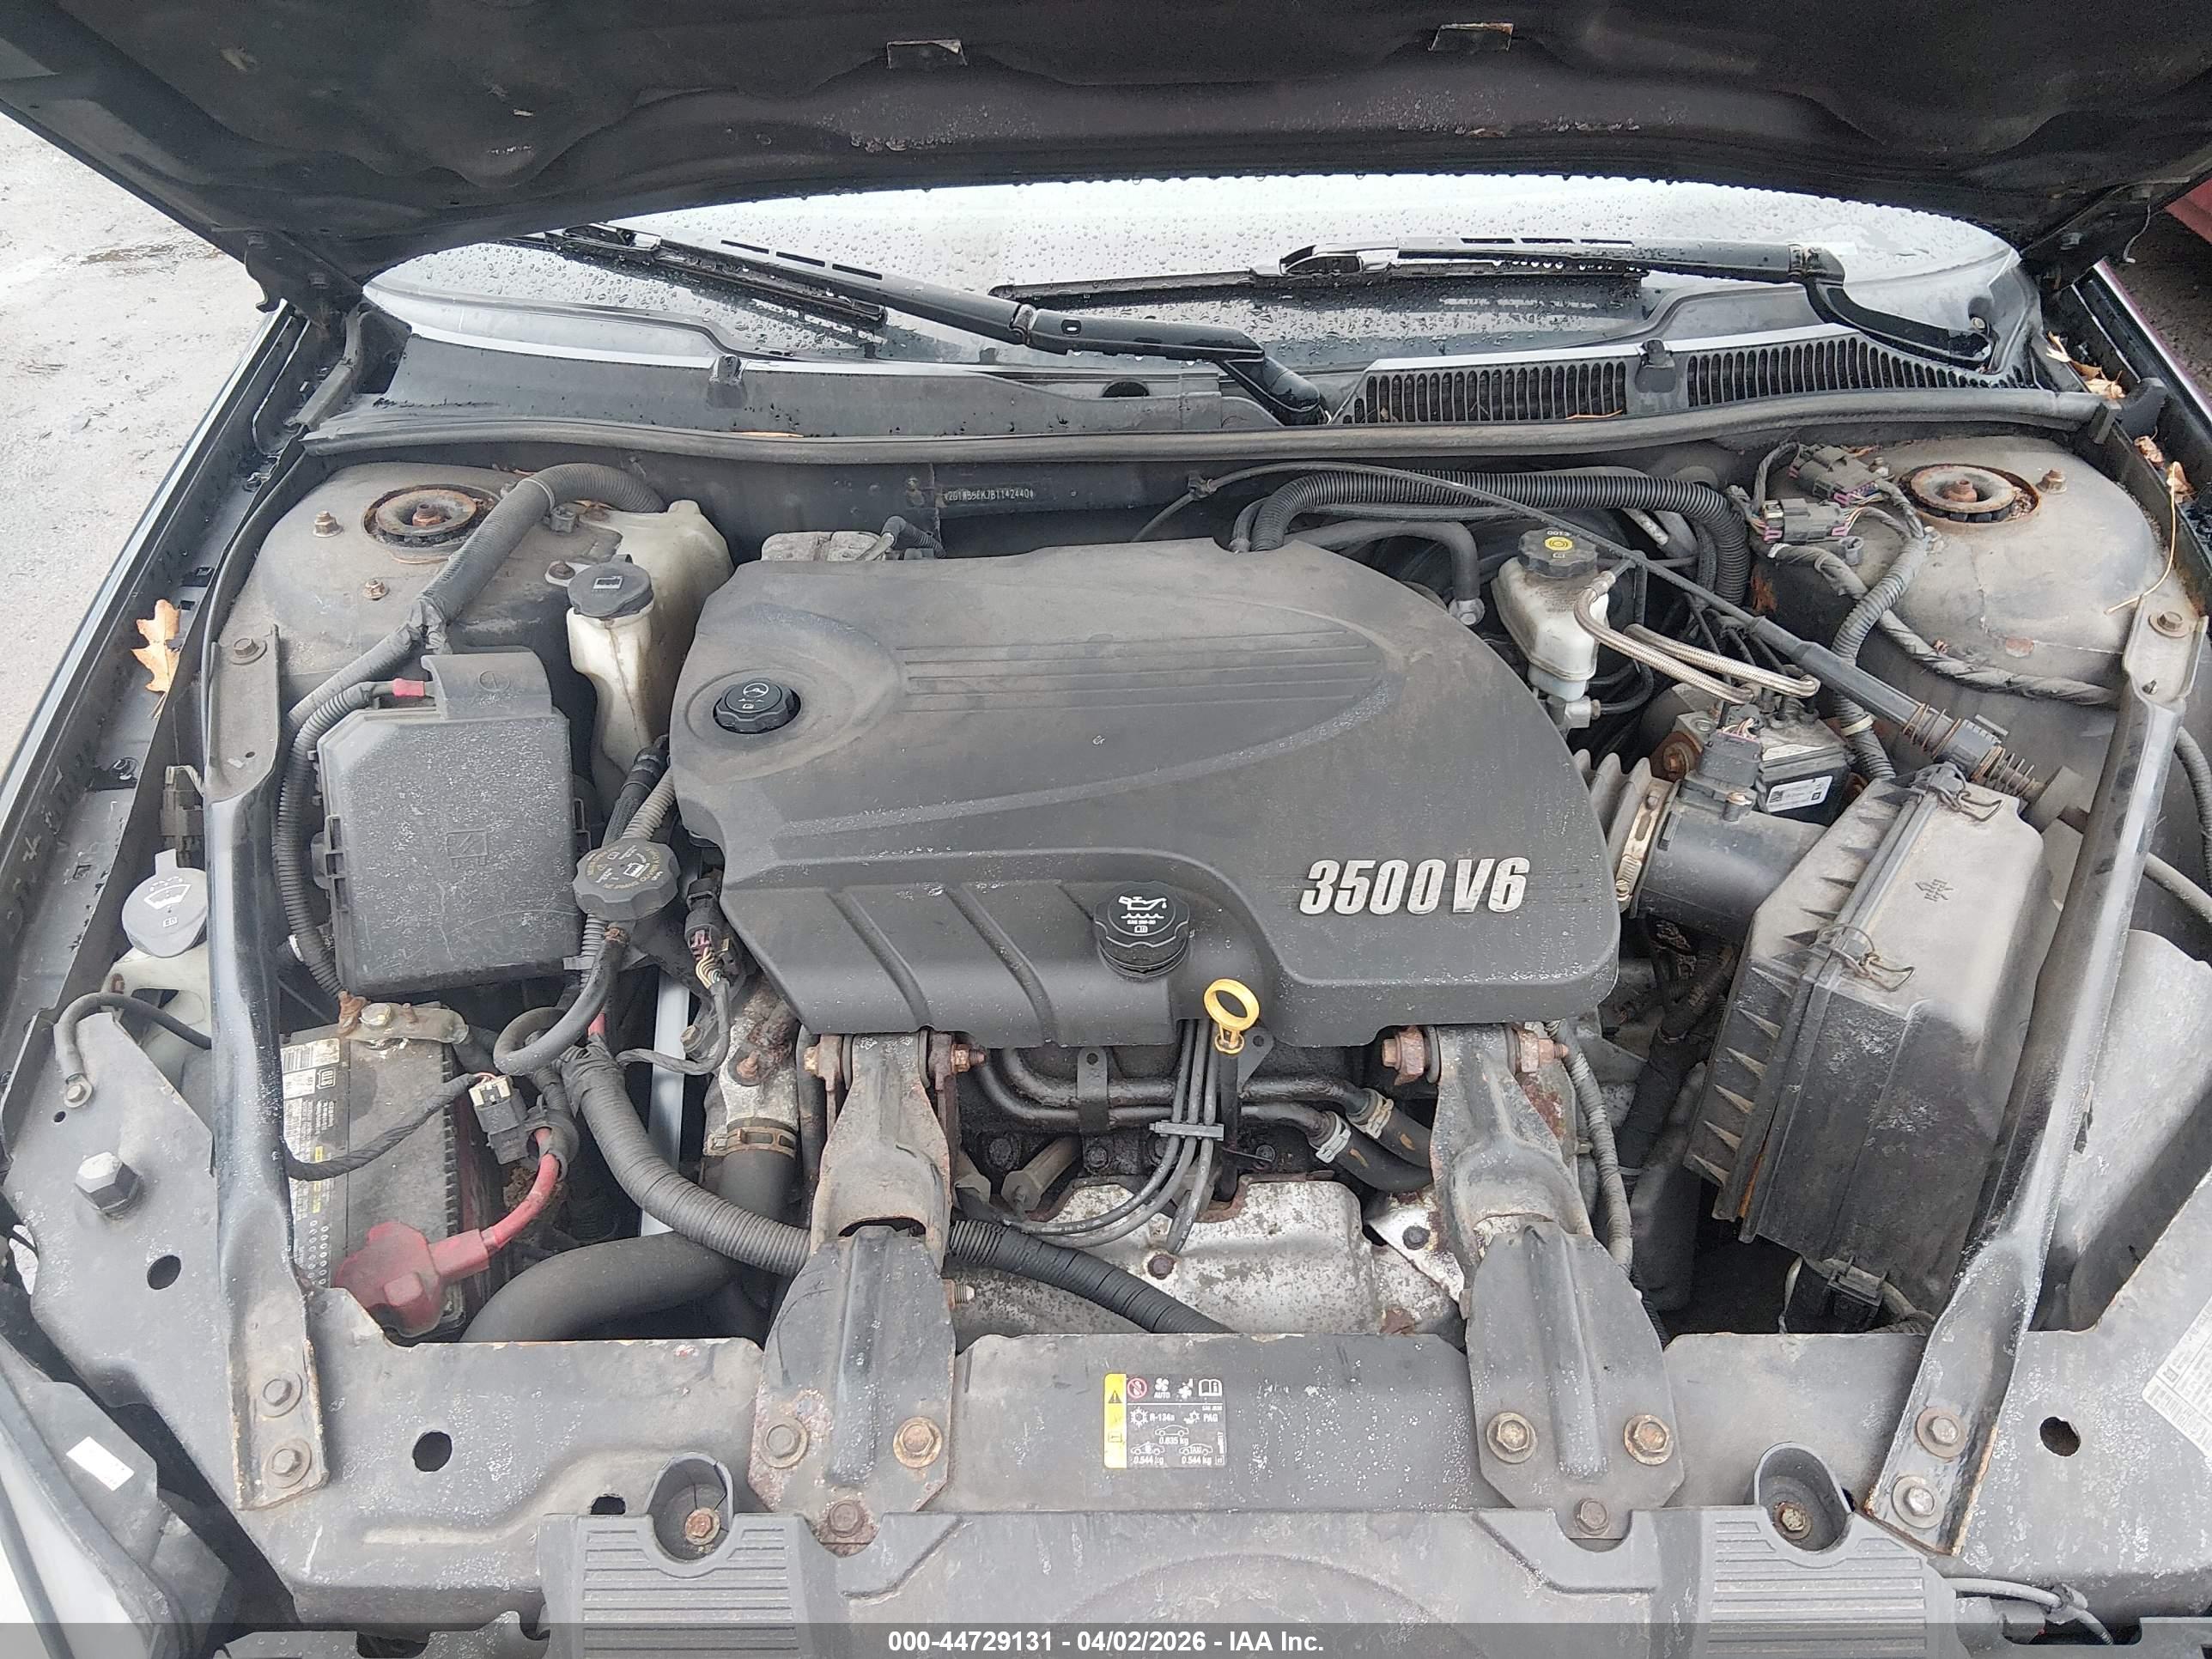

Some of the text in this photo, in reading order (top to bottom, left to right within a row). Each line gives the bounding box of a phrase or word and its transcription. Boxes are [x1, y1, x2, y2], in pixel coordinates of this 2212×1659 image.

[1298, 856, 1531, 915] 3500 V6
[1149, 1413, 1176, 1422] R-134a
[1203, 1413, 1218, 1423] PAG
[1179, 1437, 1189, 1445] kg
[1202, 1455, 1212, 1465] kg
